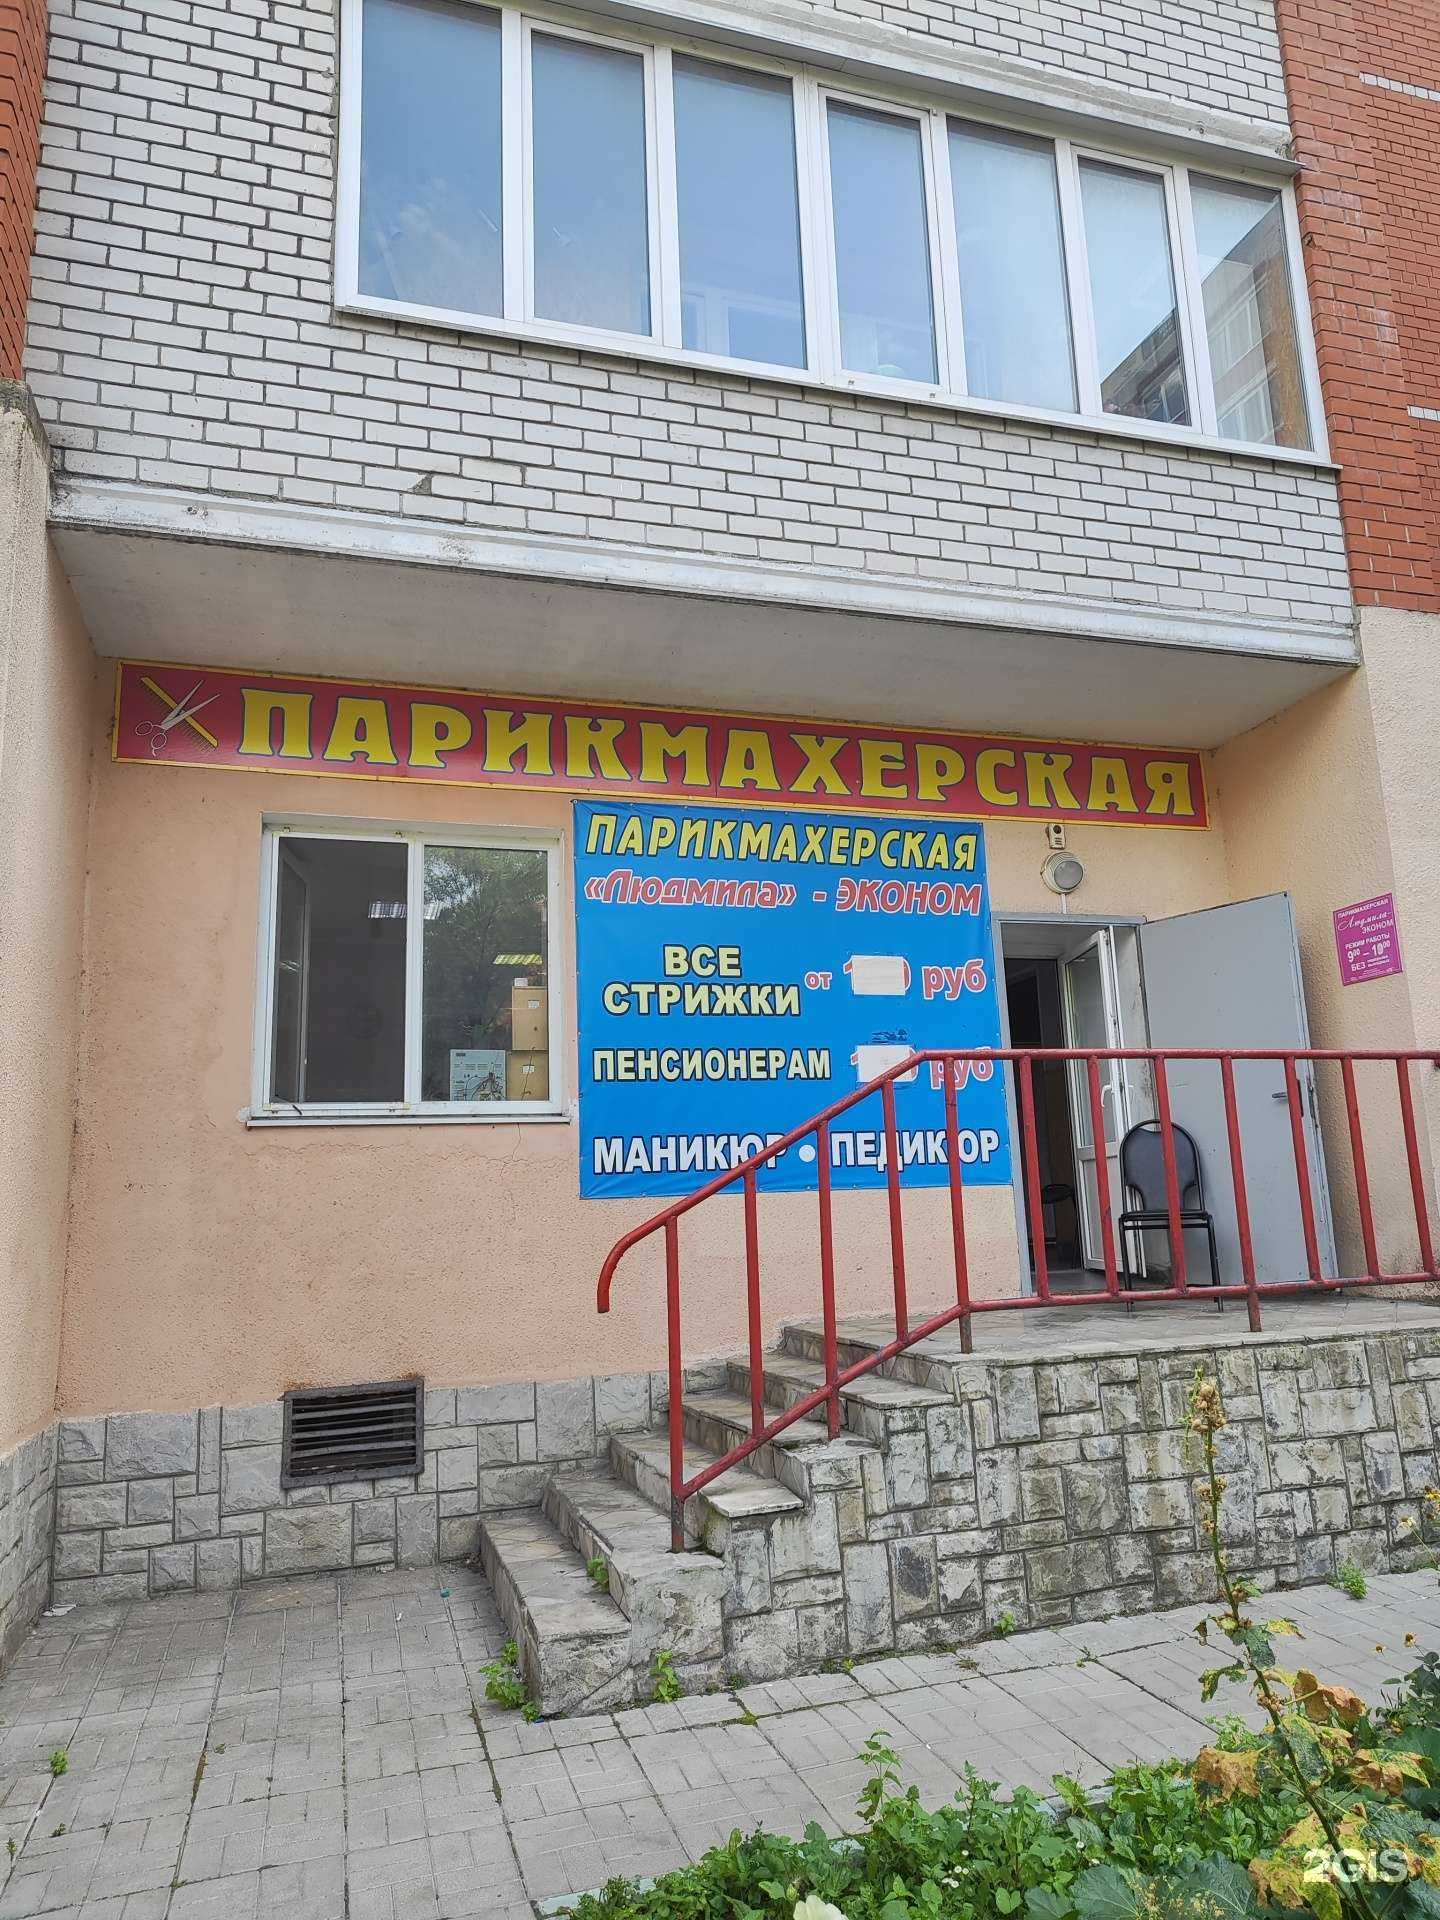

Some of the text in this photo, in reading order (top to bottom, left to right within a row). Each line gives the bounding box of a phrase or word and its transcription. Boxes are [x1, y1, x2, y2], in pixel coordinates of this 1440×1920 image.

[237, 687, 1195, 816] ПАРИКМАХЕРСКАЯ
[585, 813, 978, 871] ПАРИКМАХЕРСКАЯ
[583, 869, 798, 909] «Людмила»
[835, 877, 982, 916] ЭКОНОМ
[663, 943, 742, 978] ВСЕ
[603, 981, 801, 1017] СТРИЖКИ
[804, 969, 832, 990] от
[922, 958, 987, 1000] руб
[592, 1047, 831, 1083] ПЕНСИОНЕРАМ
[592, 1133, 788, 1174] МАНИКЮР
